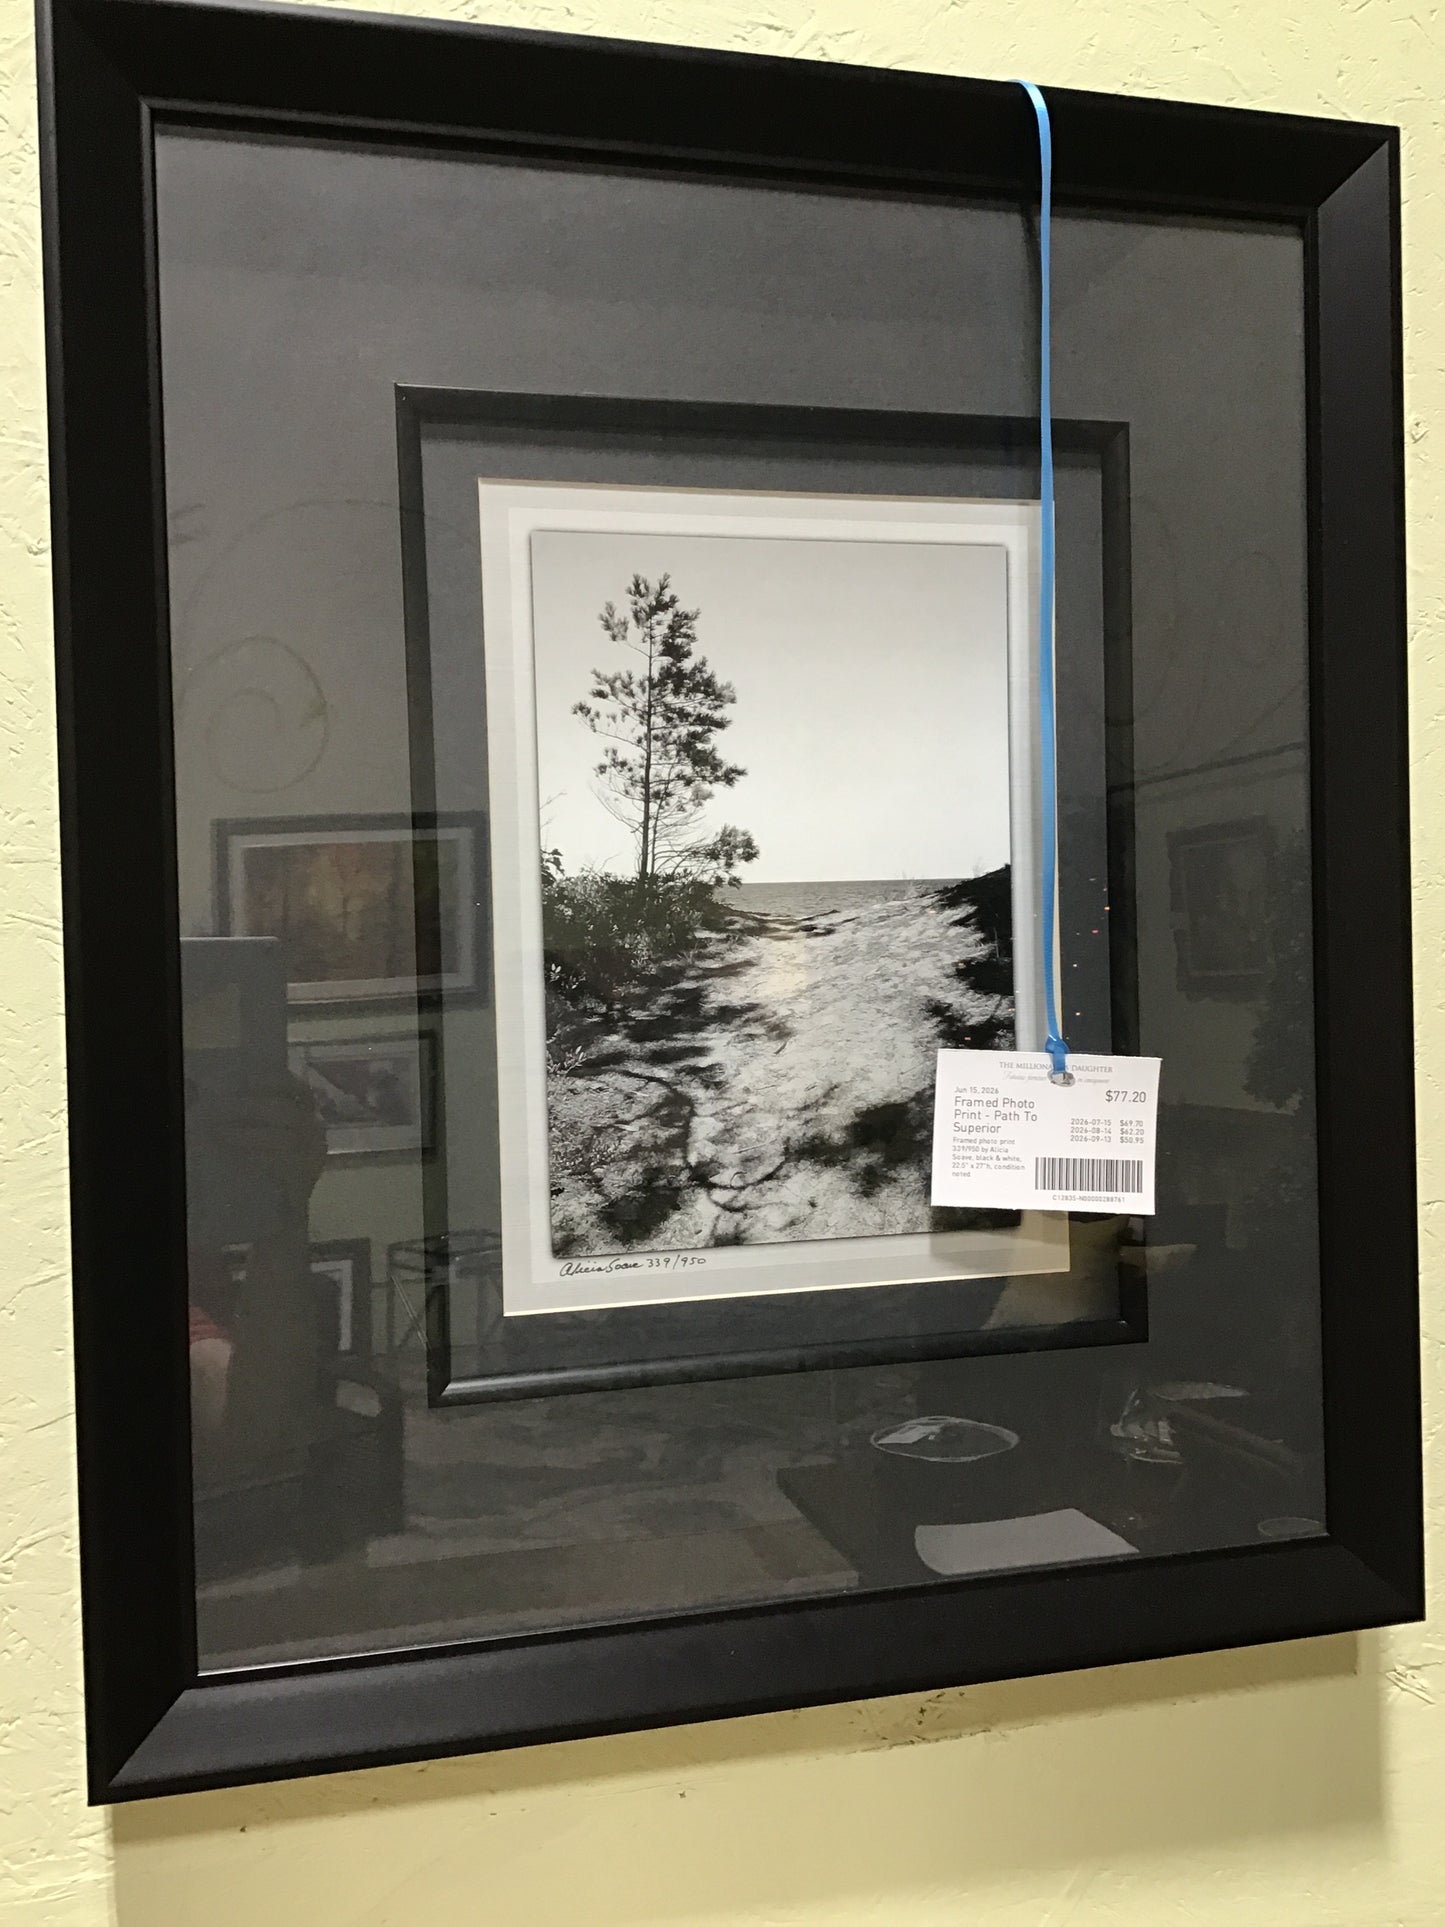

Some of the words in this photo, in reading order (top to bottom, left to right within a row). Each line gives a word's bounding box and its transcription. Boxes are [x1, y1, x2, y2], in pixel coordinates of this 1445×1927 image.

[999, 1061, 1013, 1069] THE
[1072, 1064, 1113, 1073] DAUGHTER
[954, 1086, 967, 1094] Jun
[981, 1087, 1000, 1095] 2026
[1105, 1089, 1147, 1103] $77.20
[954, 1096, 999, 1108] Framed
[1002, 1097, 1035, 1109] Photo
[954, 1108, 982, 1120] Print
[994, 1110, 1020, 1121] Path
[1024, 1110, 1038, 1122] To
[953, 1121, 1002, 1135] Superior
[1070, 1118, 1112, 1126] 2026-07-15
[1119, 1119, 1144, 1127] $69.70
[1070, 1126, 1112, 1134] 2026-08-14
[1119, 1127, 1145, 1135] $62.20
[952, 1136, 977, 1144] Framed
[978, 1137, 998, 1145] photo
[1070, 1134, 1112, 1143] 2026-09-13
[1119, 1136, 1145, 1144] $50.95
[645, 1254, 707, 1270] 339/950
